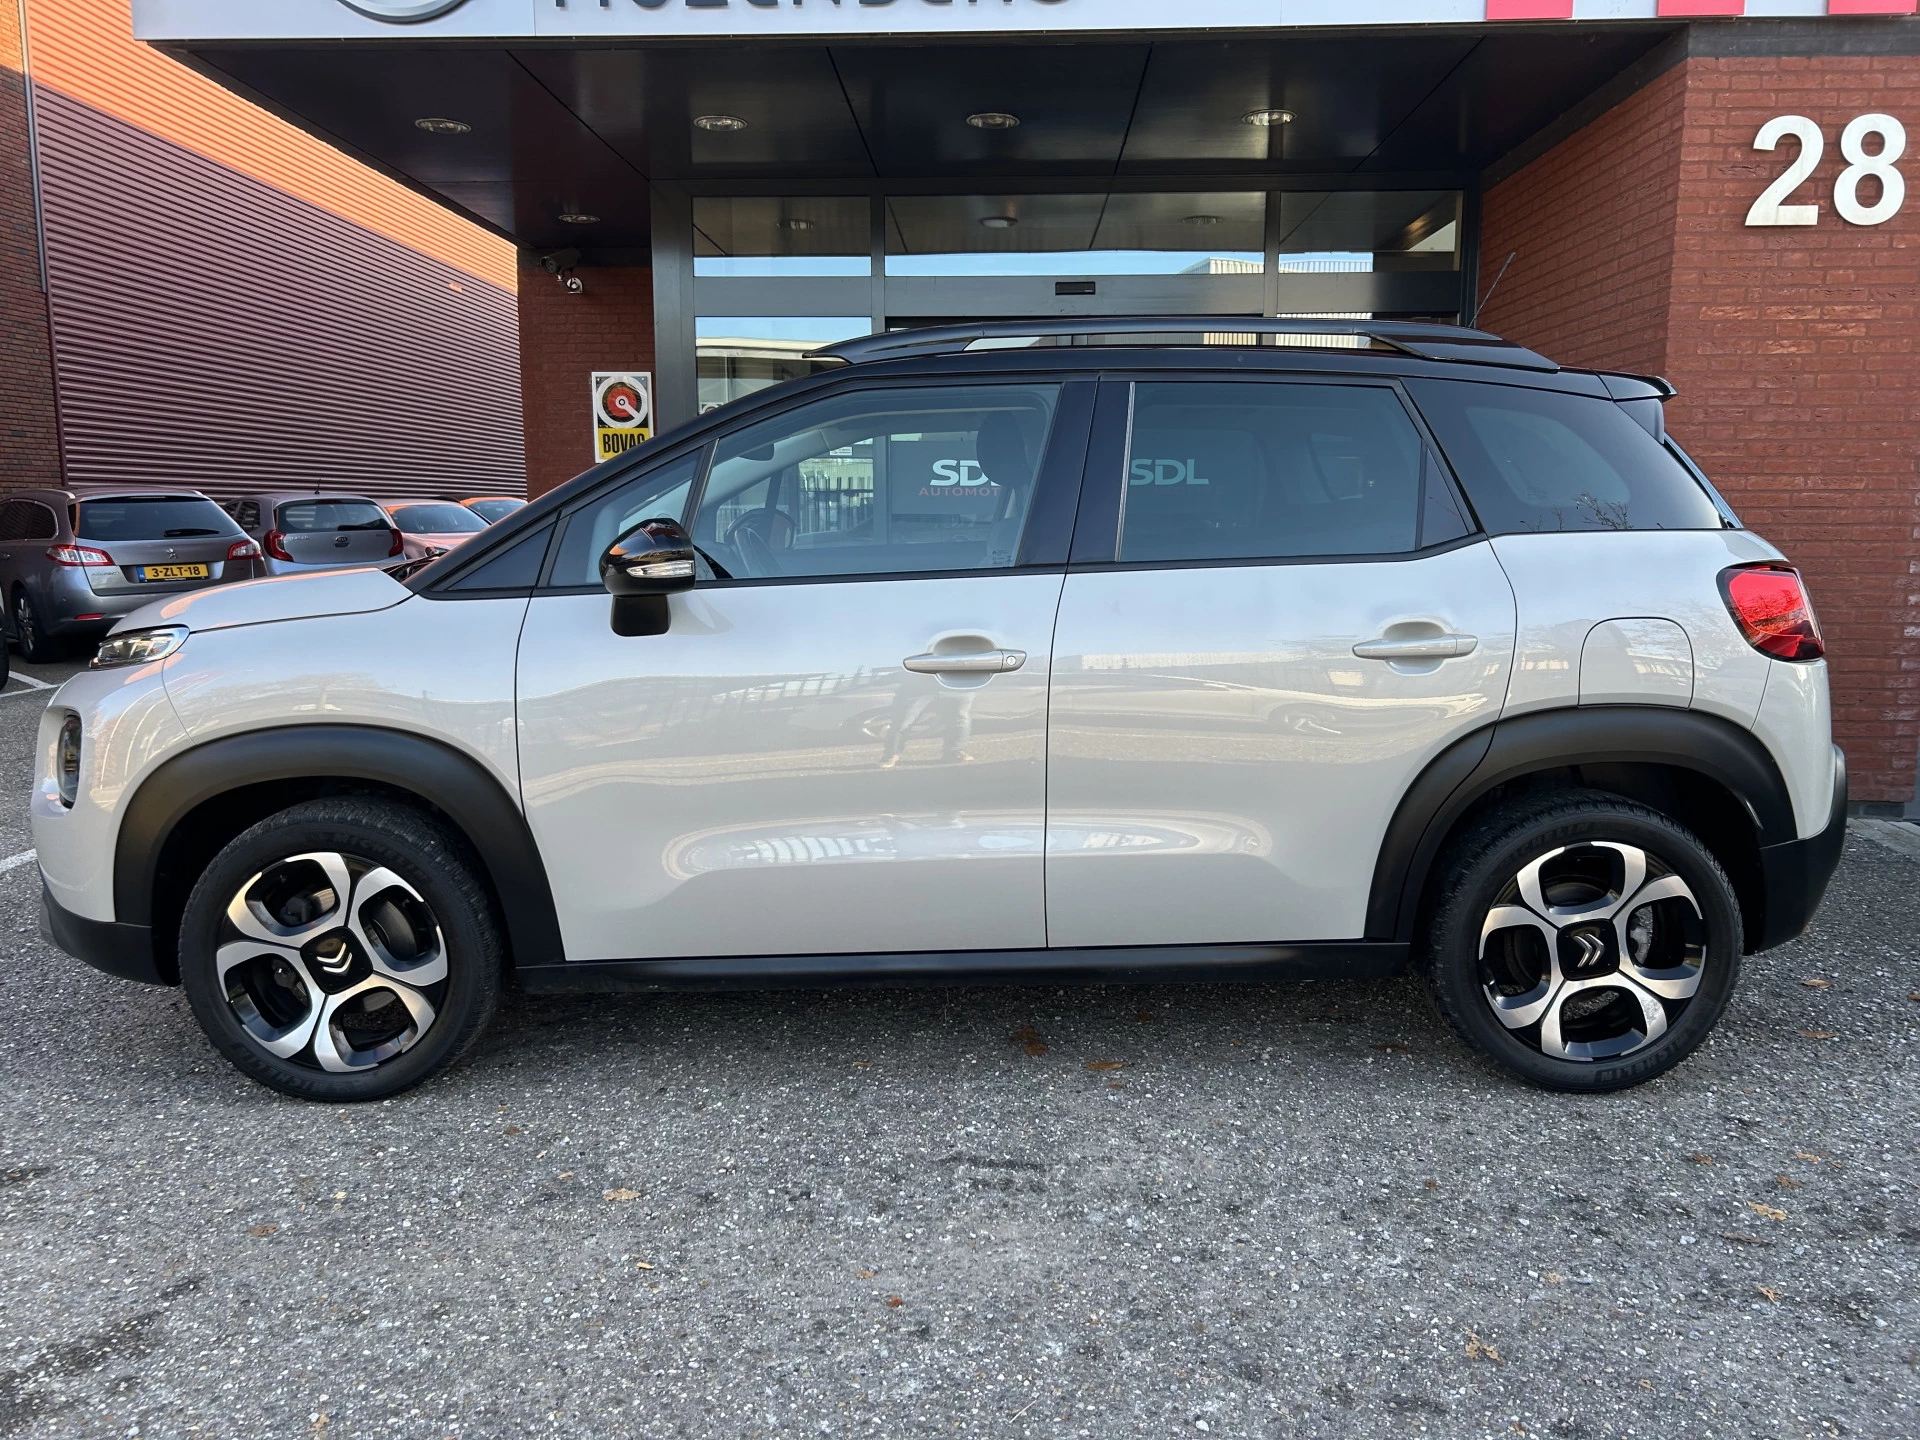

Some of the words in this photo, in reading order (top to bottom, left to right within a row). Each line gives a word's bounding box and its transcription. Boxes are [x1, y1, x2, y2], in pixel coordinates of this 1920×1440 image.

[1745, 113, 1906, 226] 28
[930, 459, 1001, 487] SD
[1129, 458, 1209, 486] SDL
[151, 565, 201, 578] 3-ZLT-18
